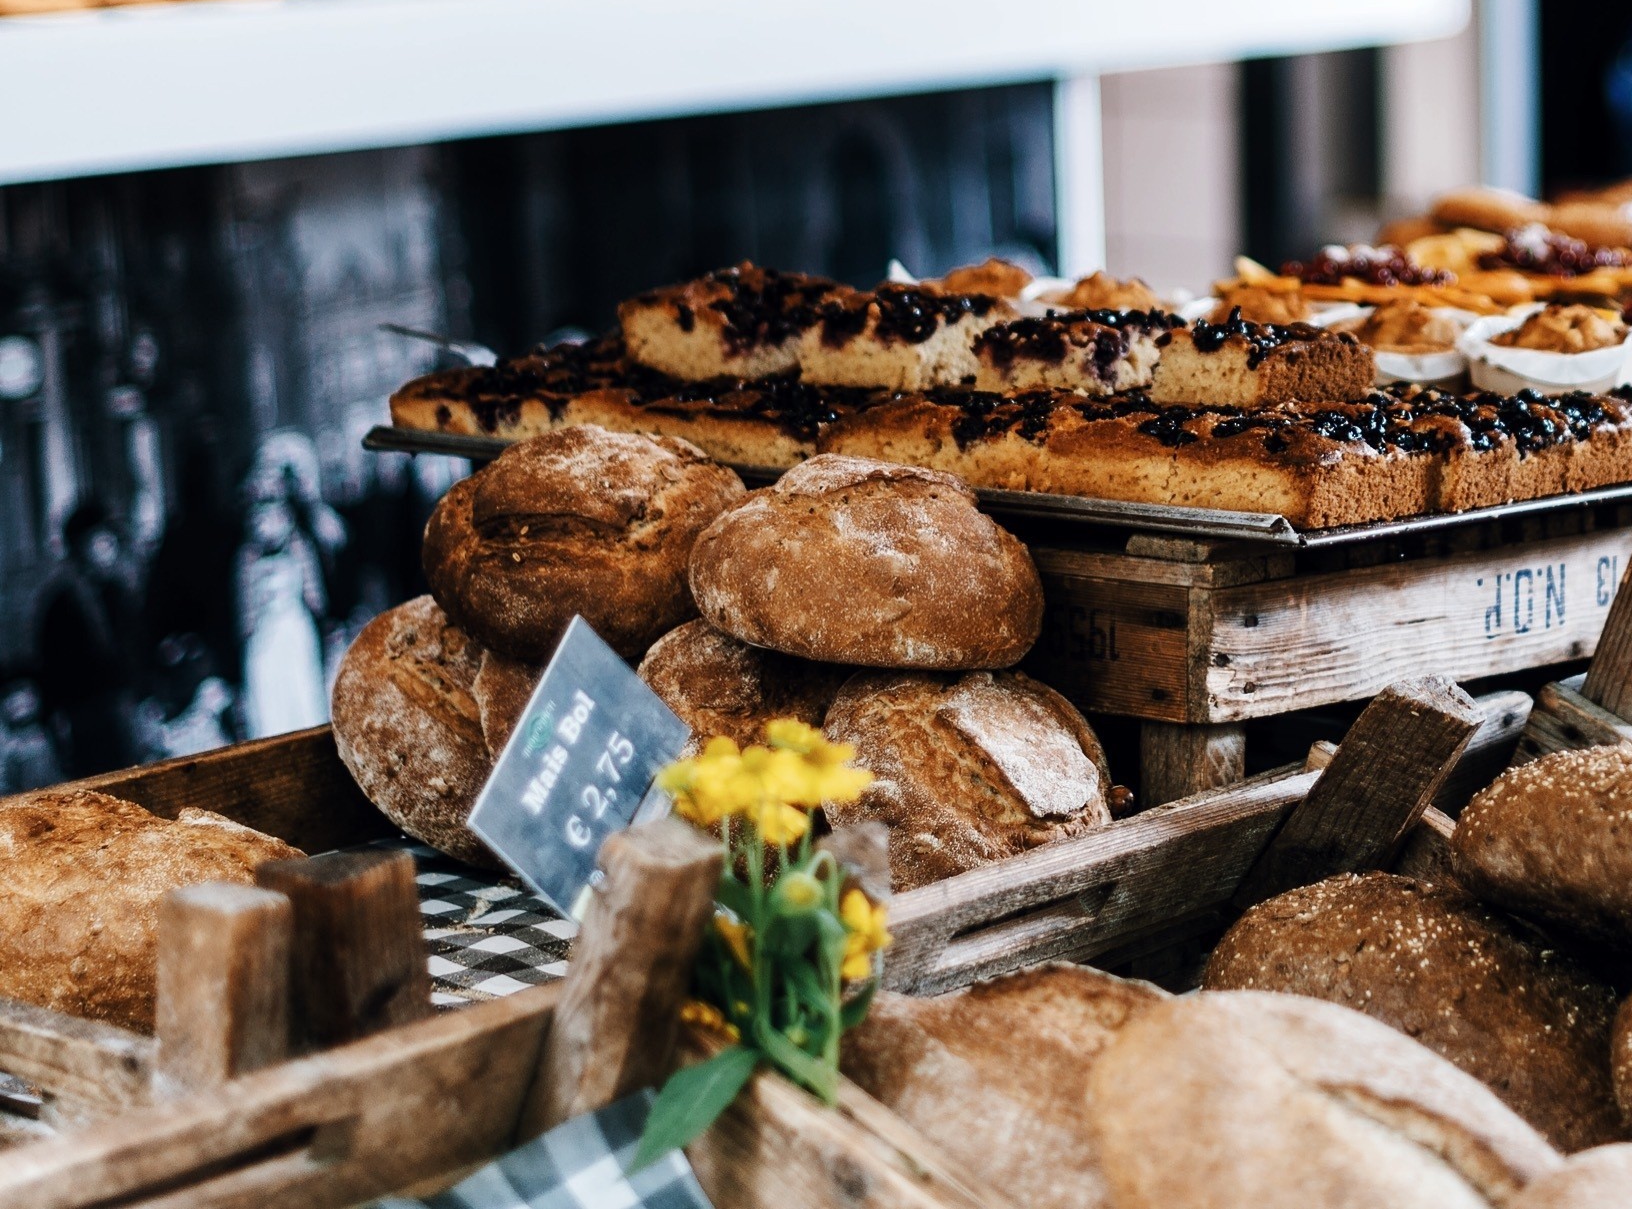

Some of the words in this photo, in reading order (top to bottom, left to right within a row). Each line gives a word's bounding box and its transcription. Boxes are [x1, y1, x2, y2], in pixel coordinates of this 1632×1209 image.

[520, 744, 569, 816] Mais
[557, 689, 596, 744] Bol
[566, 814, 591, 847] €
[580, 730, 634, 820] 2,75
